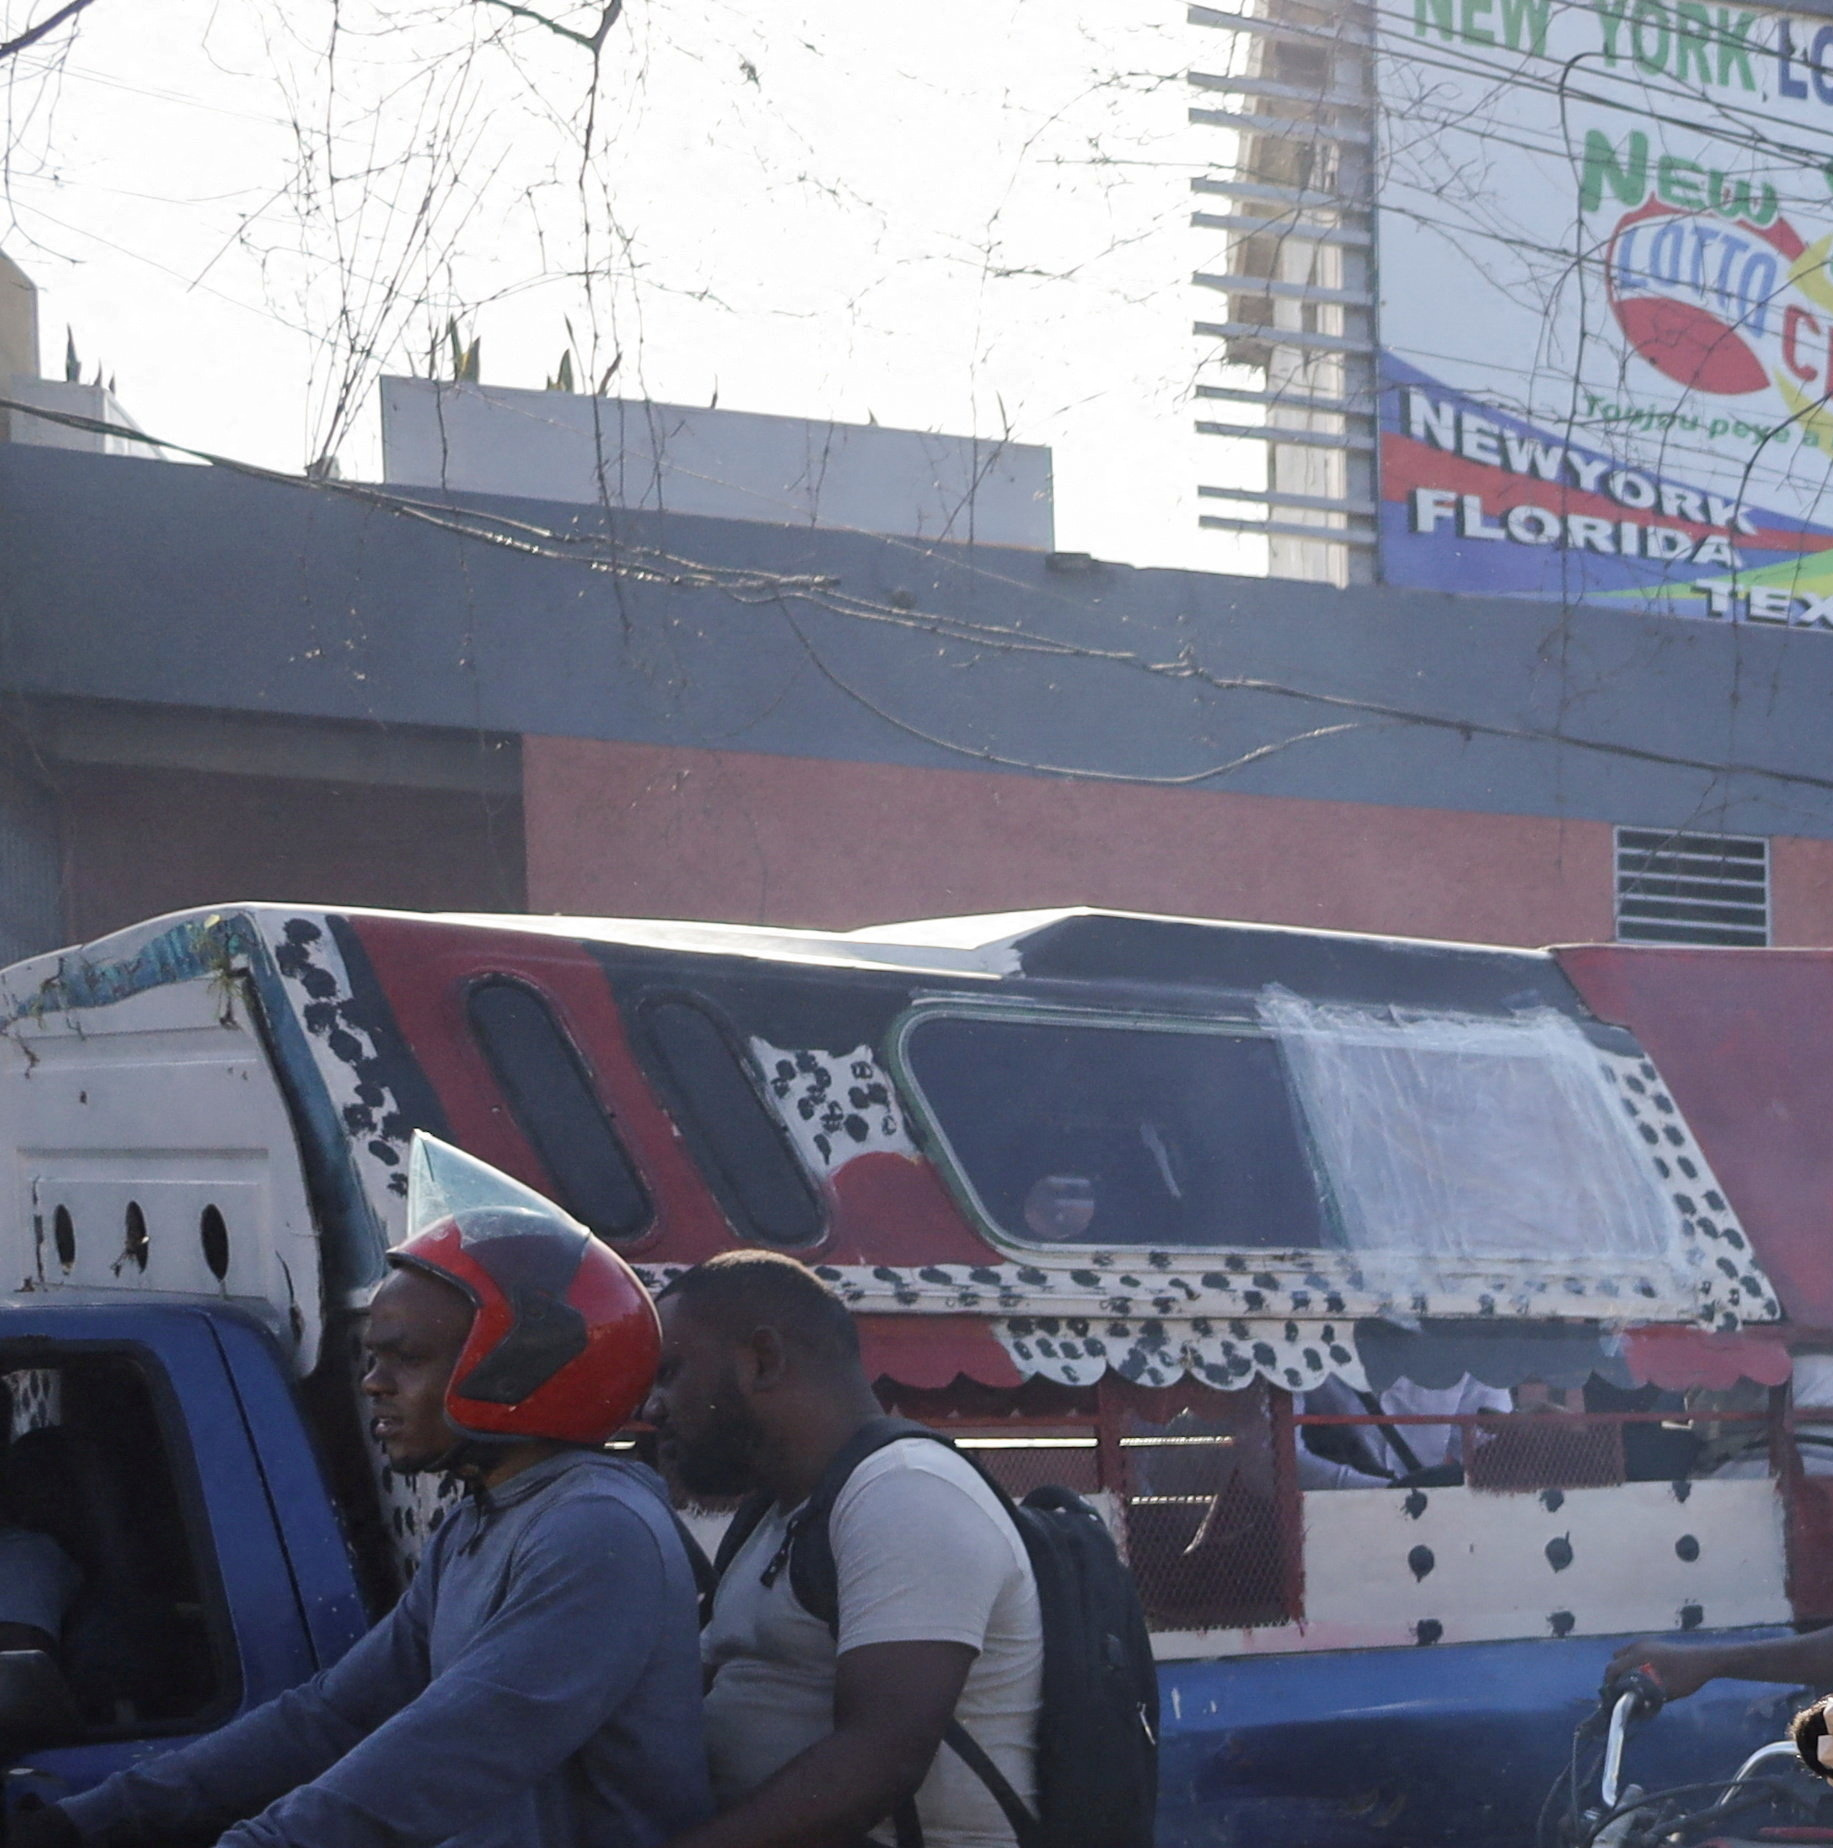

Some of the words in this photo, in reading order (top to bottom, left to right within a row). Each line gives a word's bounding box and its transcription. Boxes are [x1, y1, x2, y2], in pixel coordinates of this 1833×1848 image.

[1599, 0, 1757, 92] YORK
[1616, 221, 1777, 339] LOTTO
[1404, 387, 1757, 536] NEWYORK
[1411, 487, 1743, 570] FLORIDA
